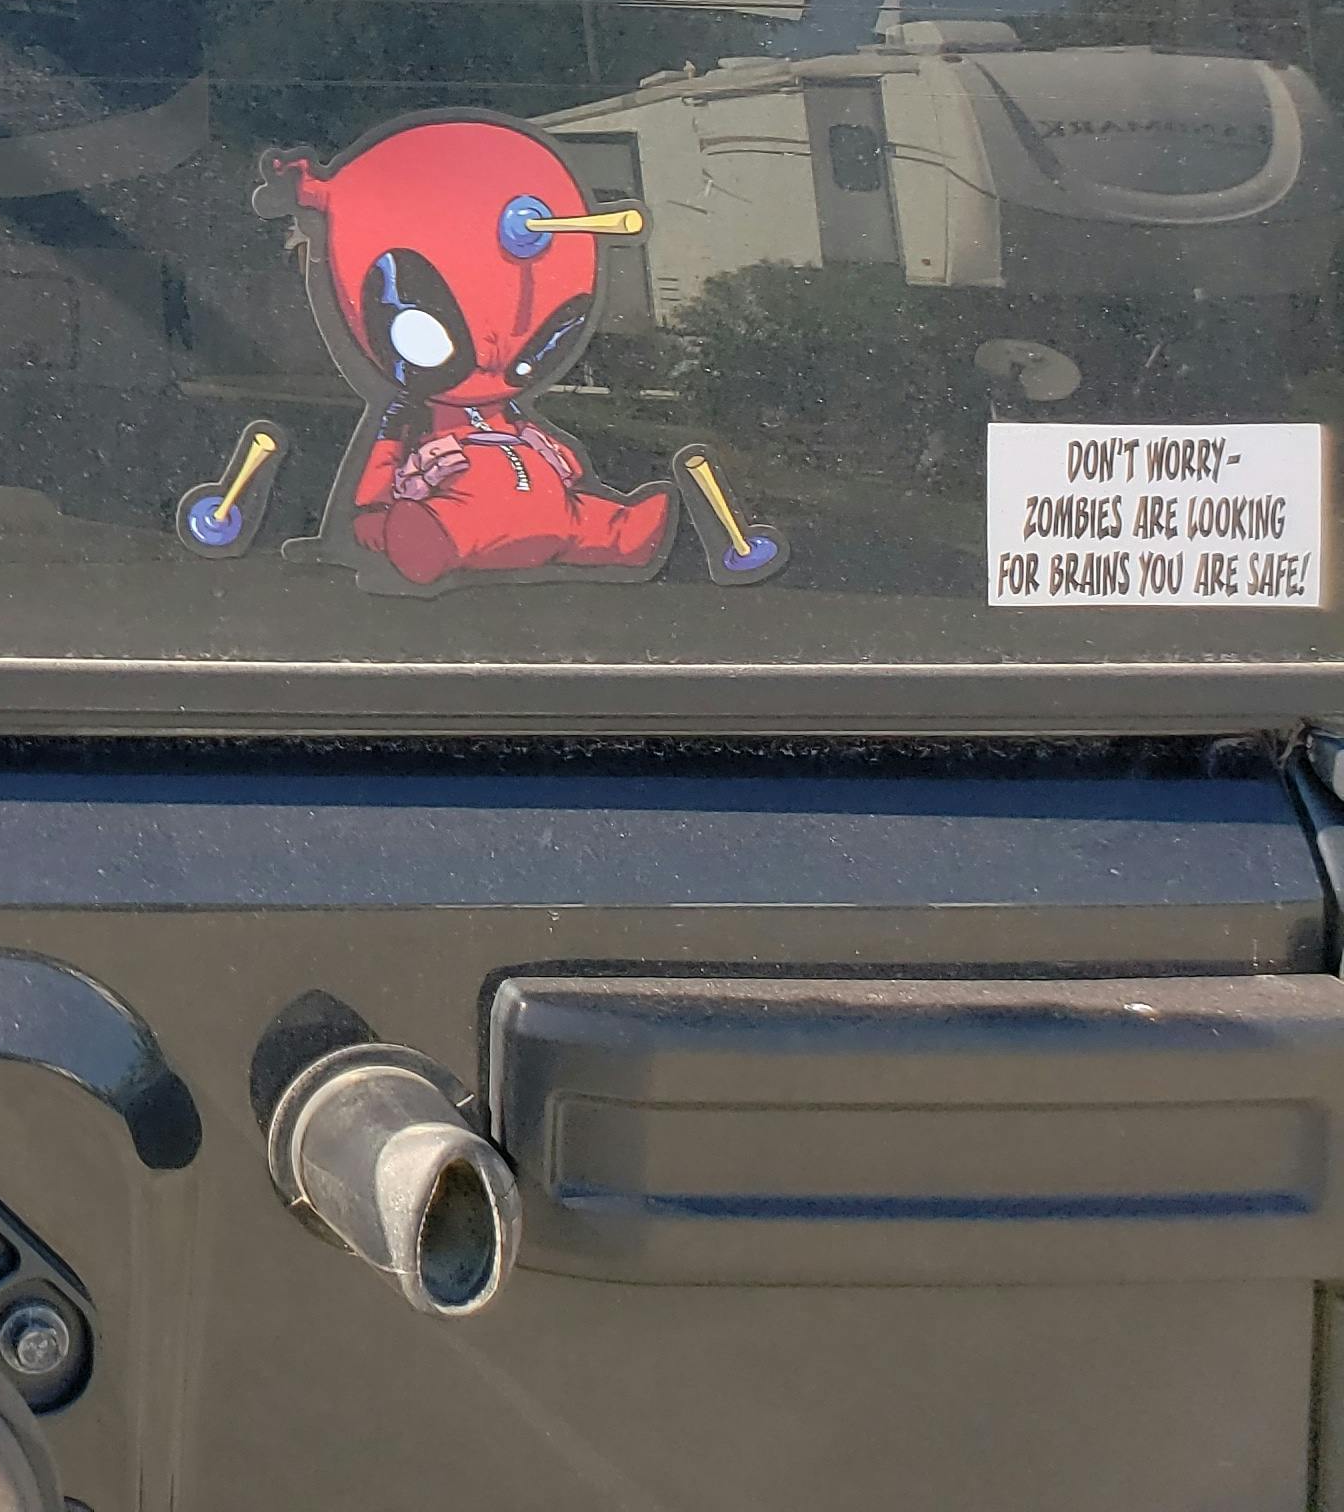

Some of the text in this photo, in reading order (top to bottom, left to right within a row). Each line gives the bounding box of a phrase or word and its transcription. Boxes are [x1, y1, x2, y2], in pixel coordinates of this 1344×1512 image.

[1067, 437, 1140, 483] DON'T
[1023, 493, 1286, 541] ZOMBIES ARE LOOKING
[997, 550, 1312, 598] FOR BRAINS YOU ARE SAFE!
